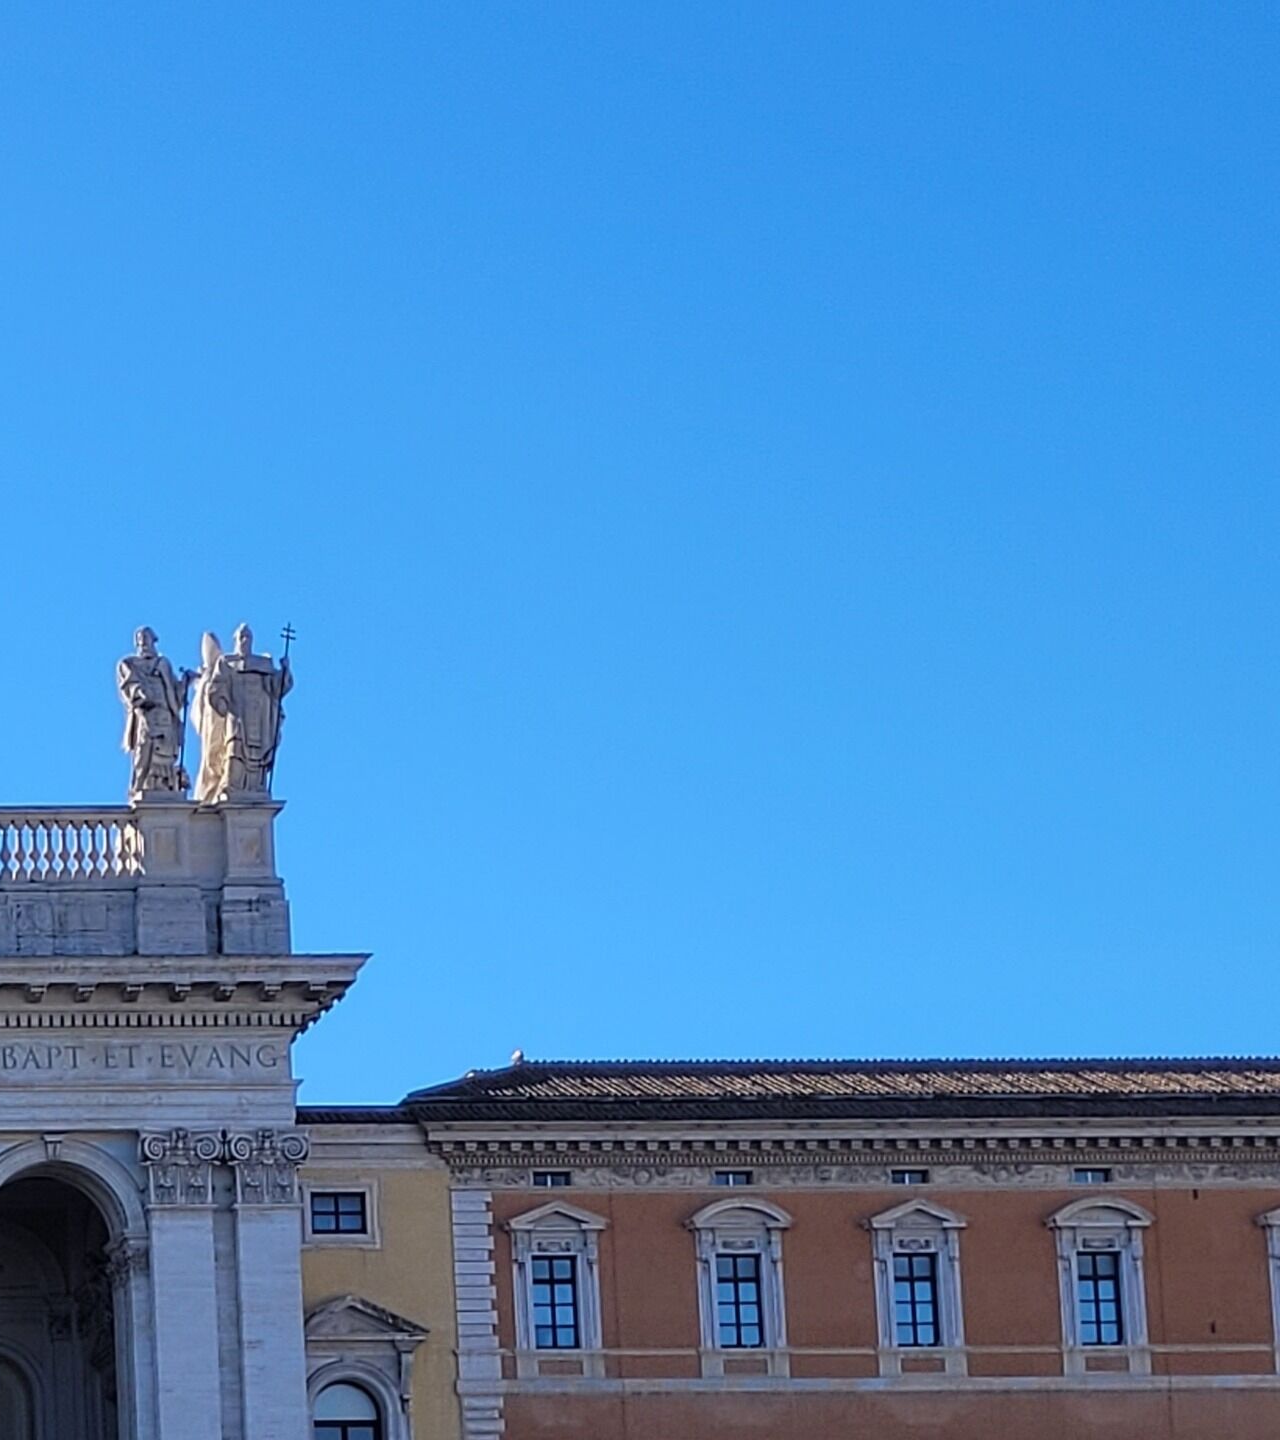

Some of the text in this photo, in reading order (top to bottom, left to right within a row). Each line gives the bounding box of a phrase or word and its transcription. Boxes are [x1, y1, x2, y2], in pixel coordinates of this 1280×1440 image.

[1, 1044, 85, 1070] BAPT
[104, 1044, 142, 1069] ET
[159, 1044, 278, 1069] EVANG
